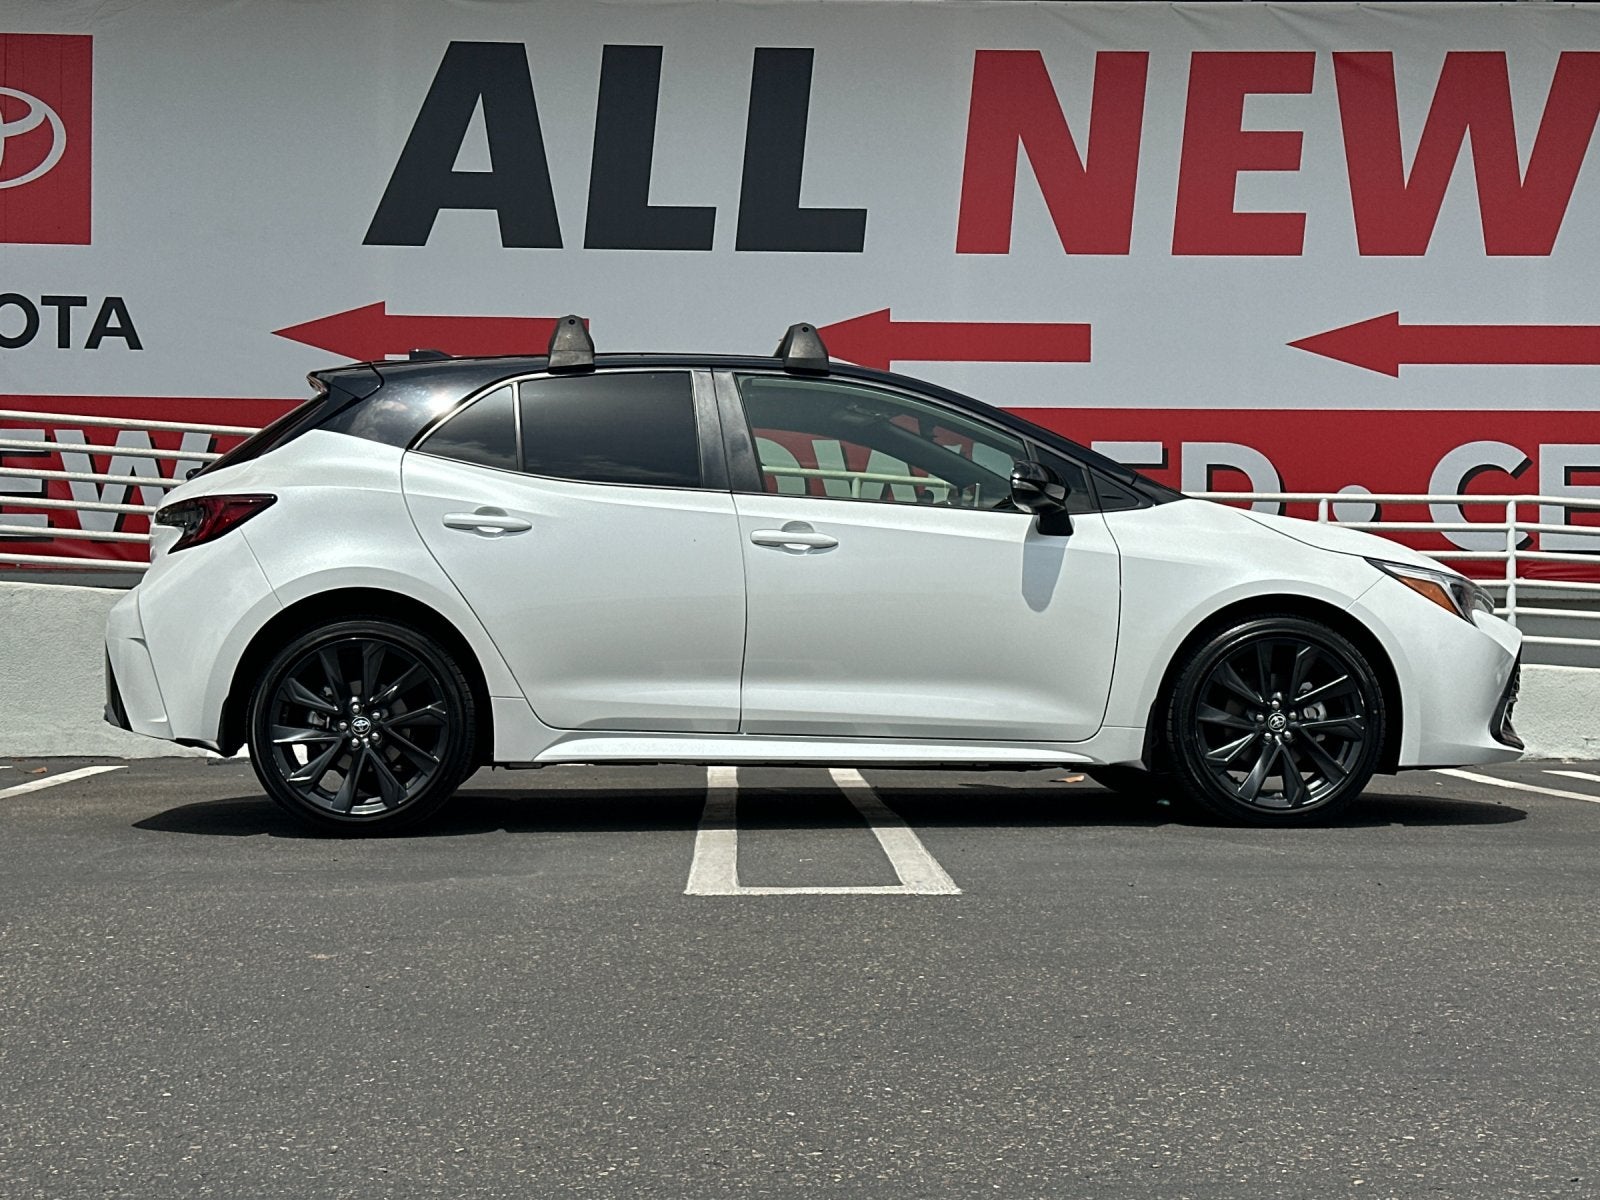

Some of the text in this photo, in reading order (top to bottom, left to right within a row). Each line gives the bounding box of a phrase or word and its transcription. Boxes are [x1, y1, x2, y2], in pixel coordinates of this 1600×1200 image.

[362, 41, 1600, 256] ALL NEW
[0, 293, 144, 350] OTA
